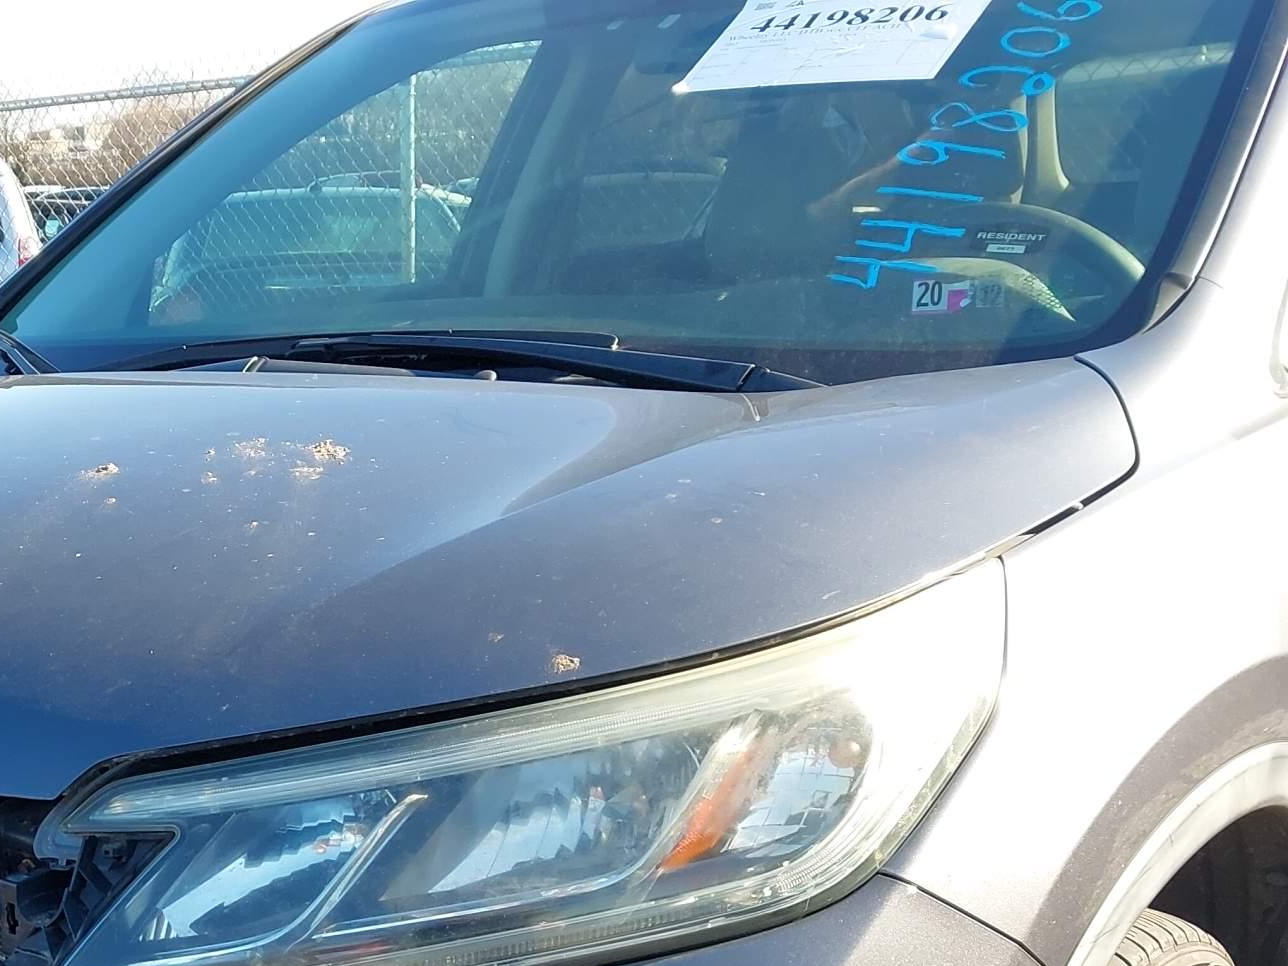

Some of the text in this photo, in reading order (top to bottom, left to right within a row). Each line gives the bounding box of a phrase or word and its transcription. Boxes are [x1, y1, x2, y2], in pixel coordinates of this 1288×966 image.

[750, 4, 953, 33] 44198206
[826, 0, 1103, 289] 44198206
[976, 231, 1047, 242] RESIDENT
[915, 281, 944, 308] 20
